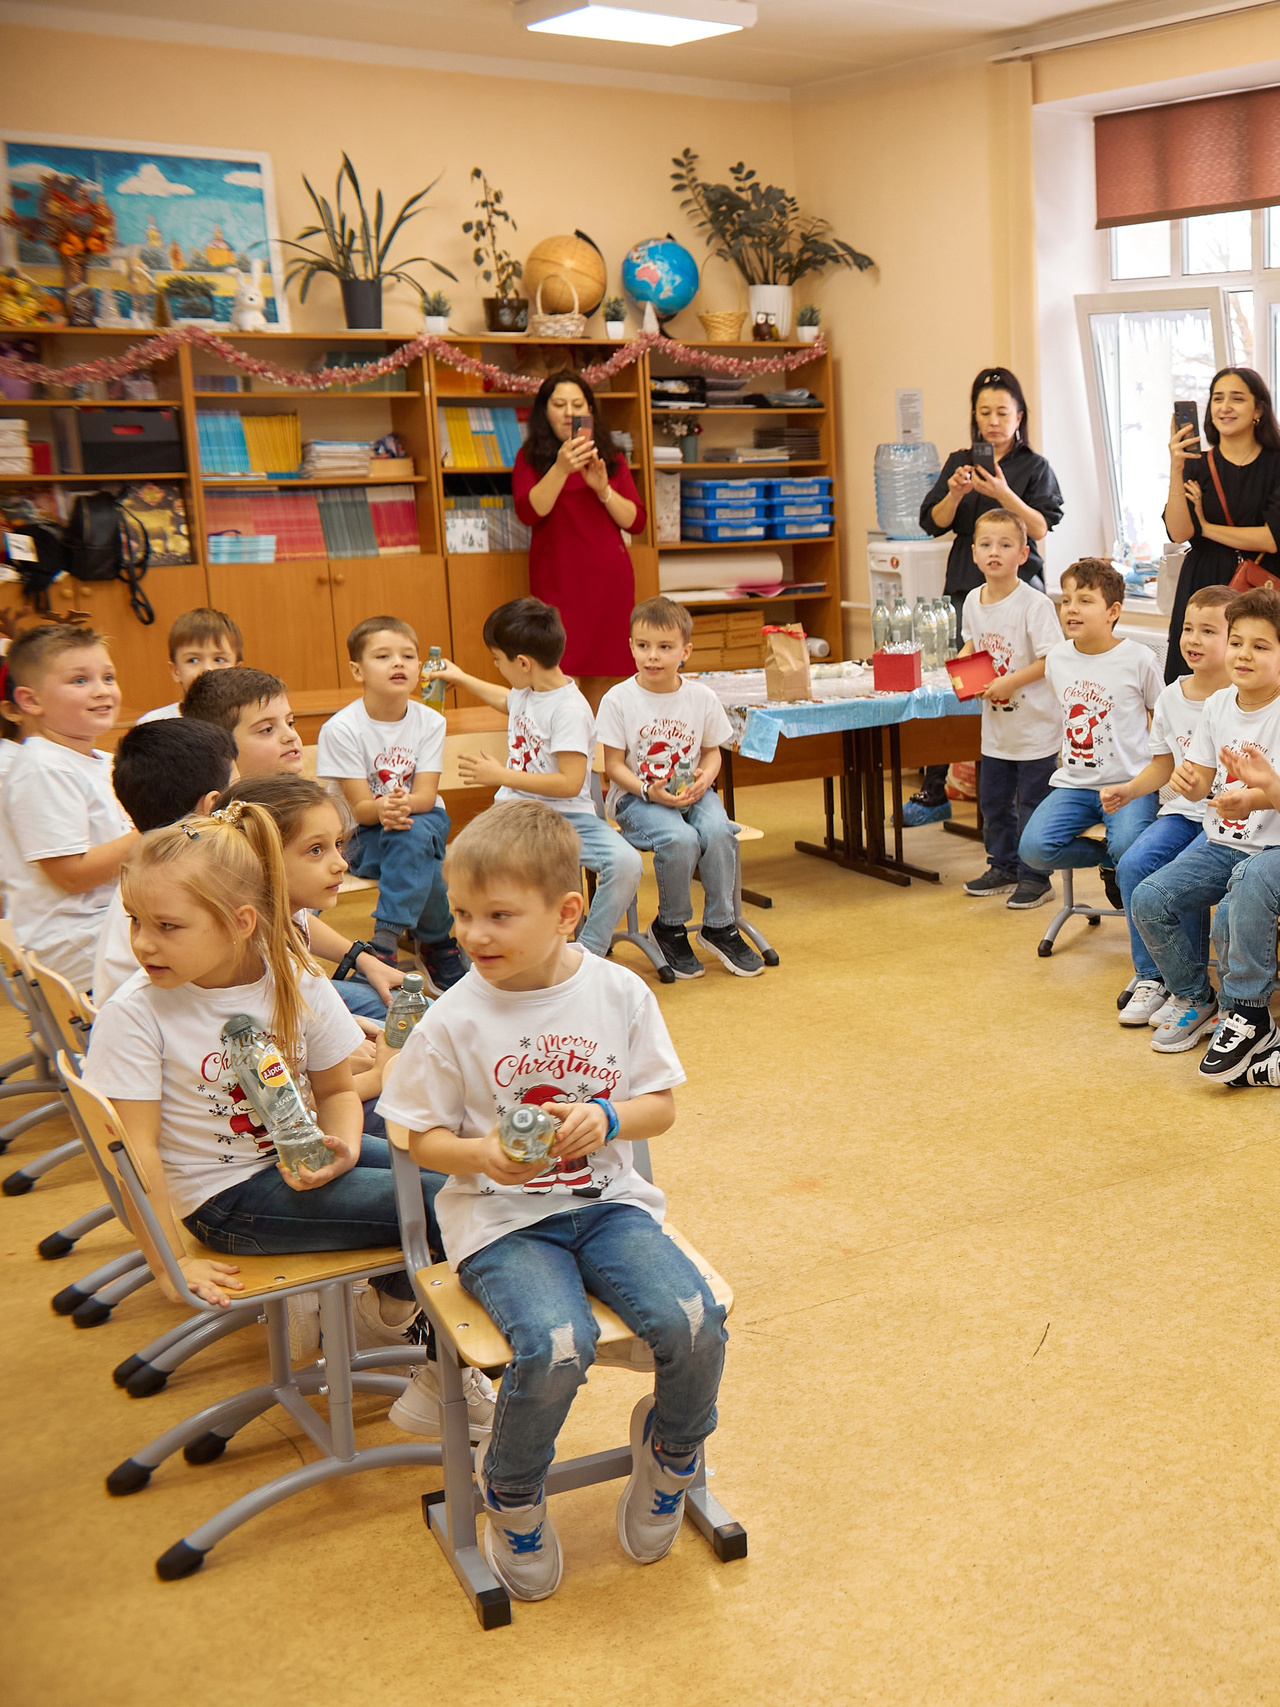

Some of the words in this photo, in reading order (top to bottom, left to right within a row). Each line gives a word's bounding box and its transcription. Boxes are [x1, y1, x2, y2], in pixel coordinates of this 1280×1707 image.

[1063, 686, 1115, 712] Christmas
[639, 724, 696, 746] Christmas
[536, 1033, 599, 1058] Merry
[494, 1049, 622, 1091] Christmas
